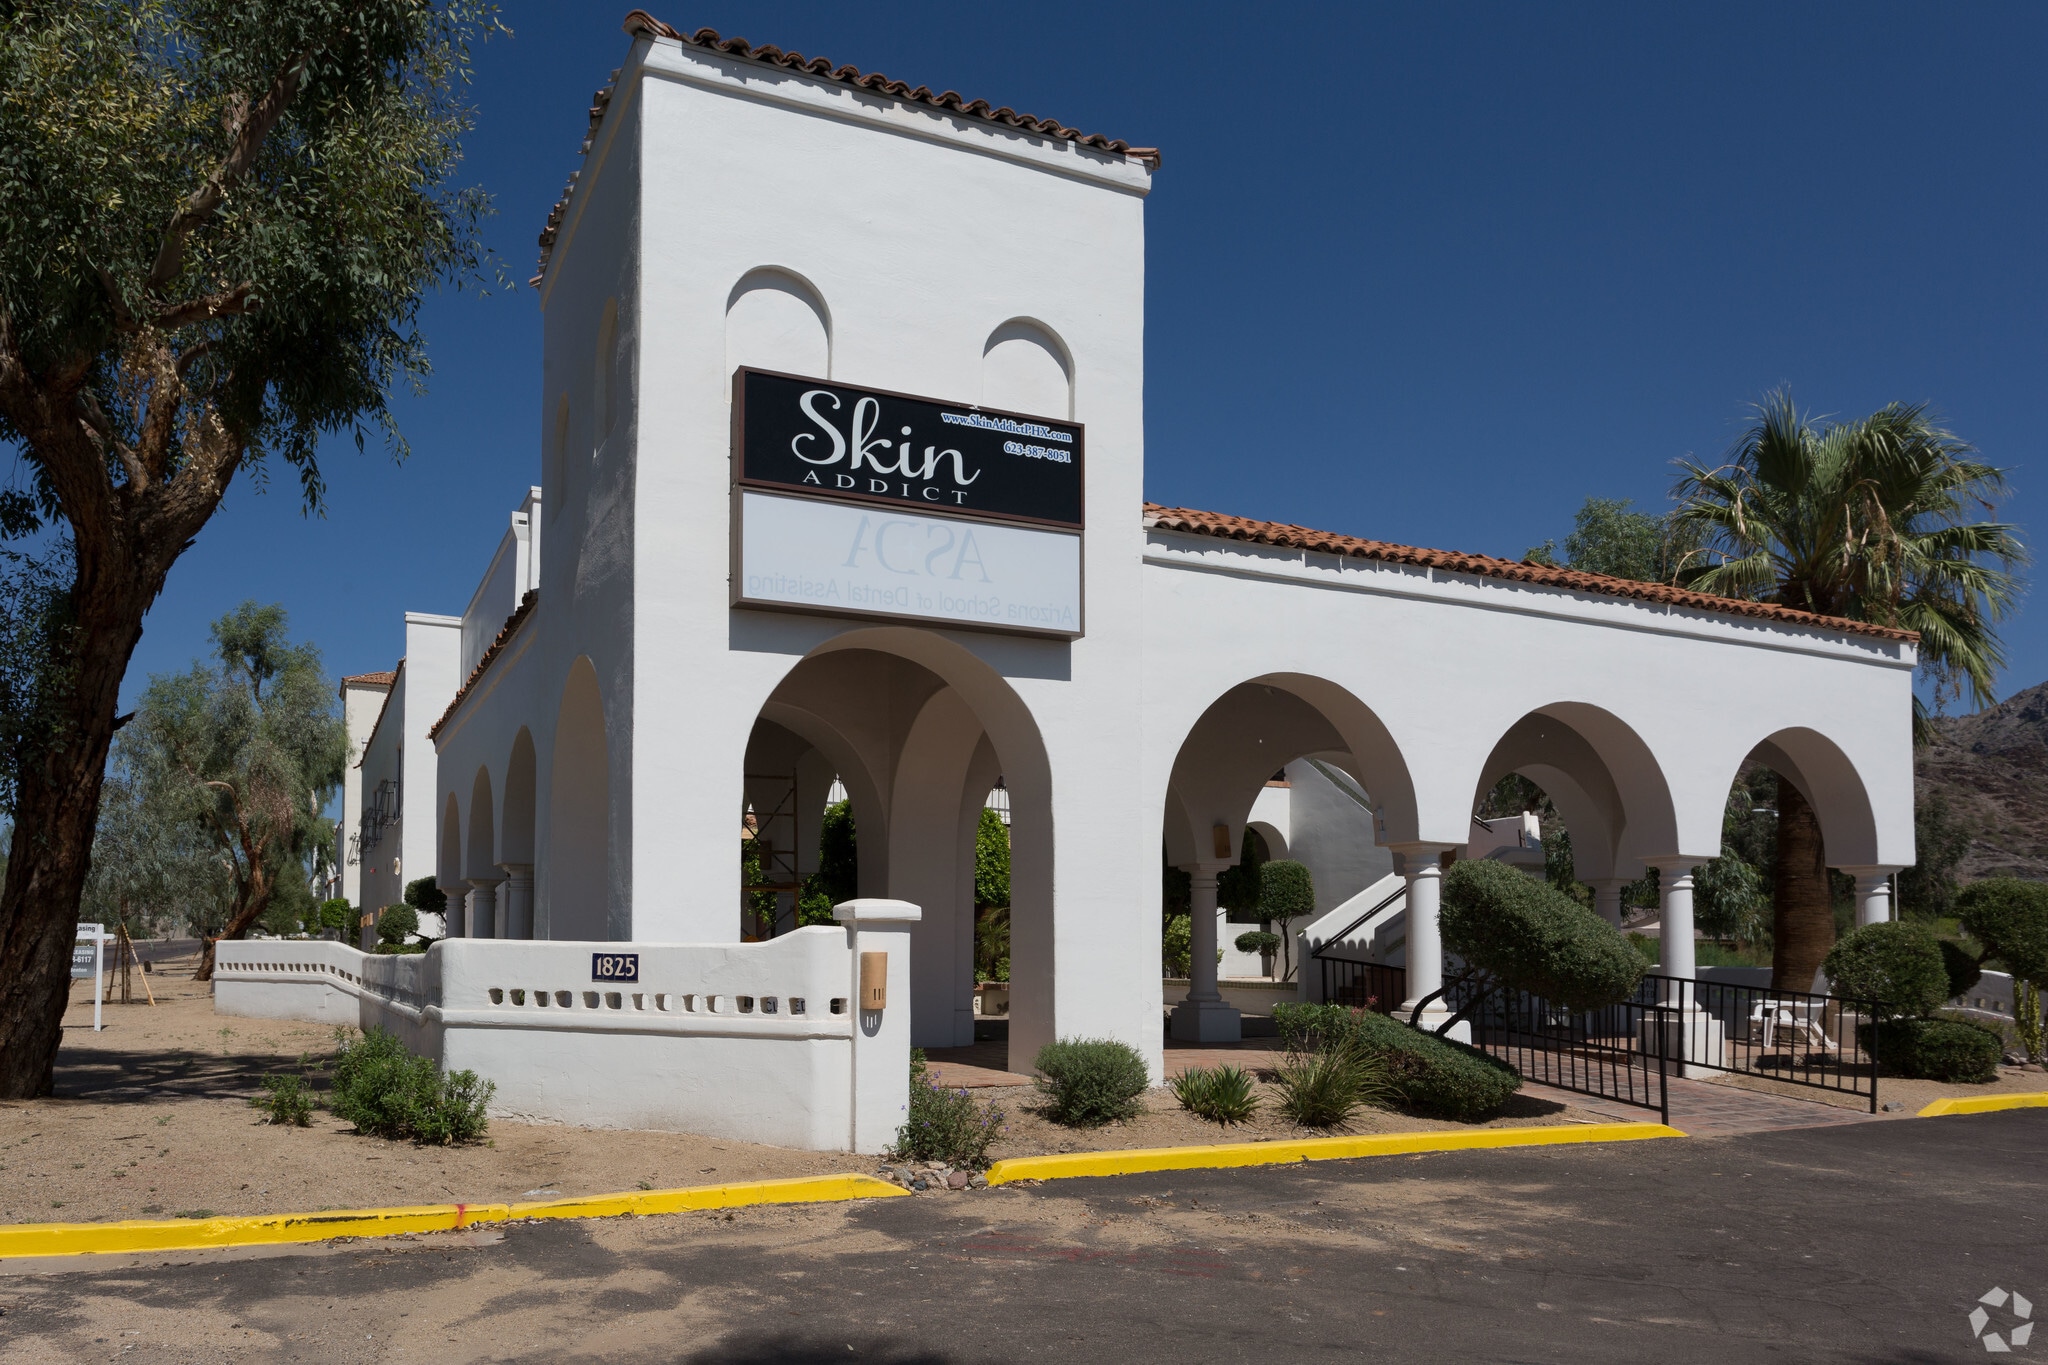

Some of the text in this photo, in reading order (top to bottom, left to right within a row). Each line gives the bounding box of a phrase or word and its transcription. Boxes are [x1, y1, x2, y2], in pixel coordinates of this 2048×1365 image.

[791, 390, 981, 485] Skin
[941, 412, 1073, 443] www.SkinAddictPHX.com
[1003, 441, 1071, 463] 623-387-8051
[802, 470, 968, 504] ADDICT
[596, 956, 636, 977] 1825
